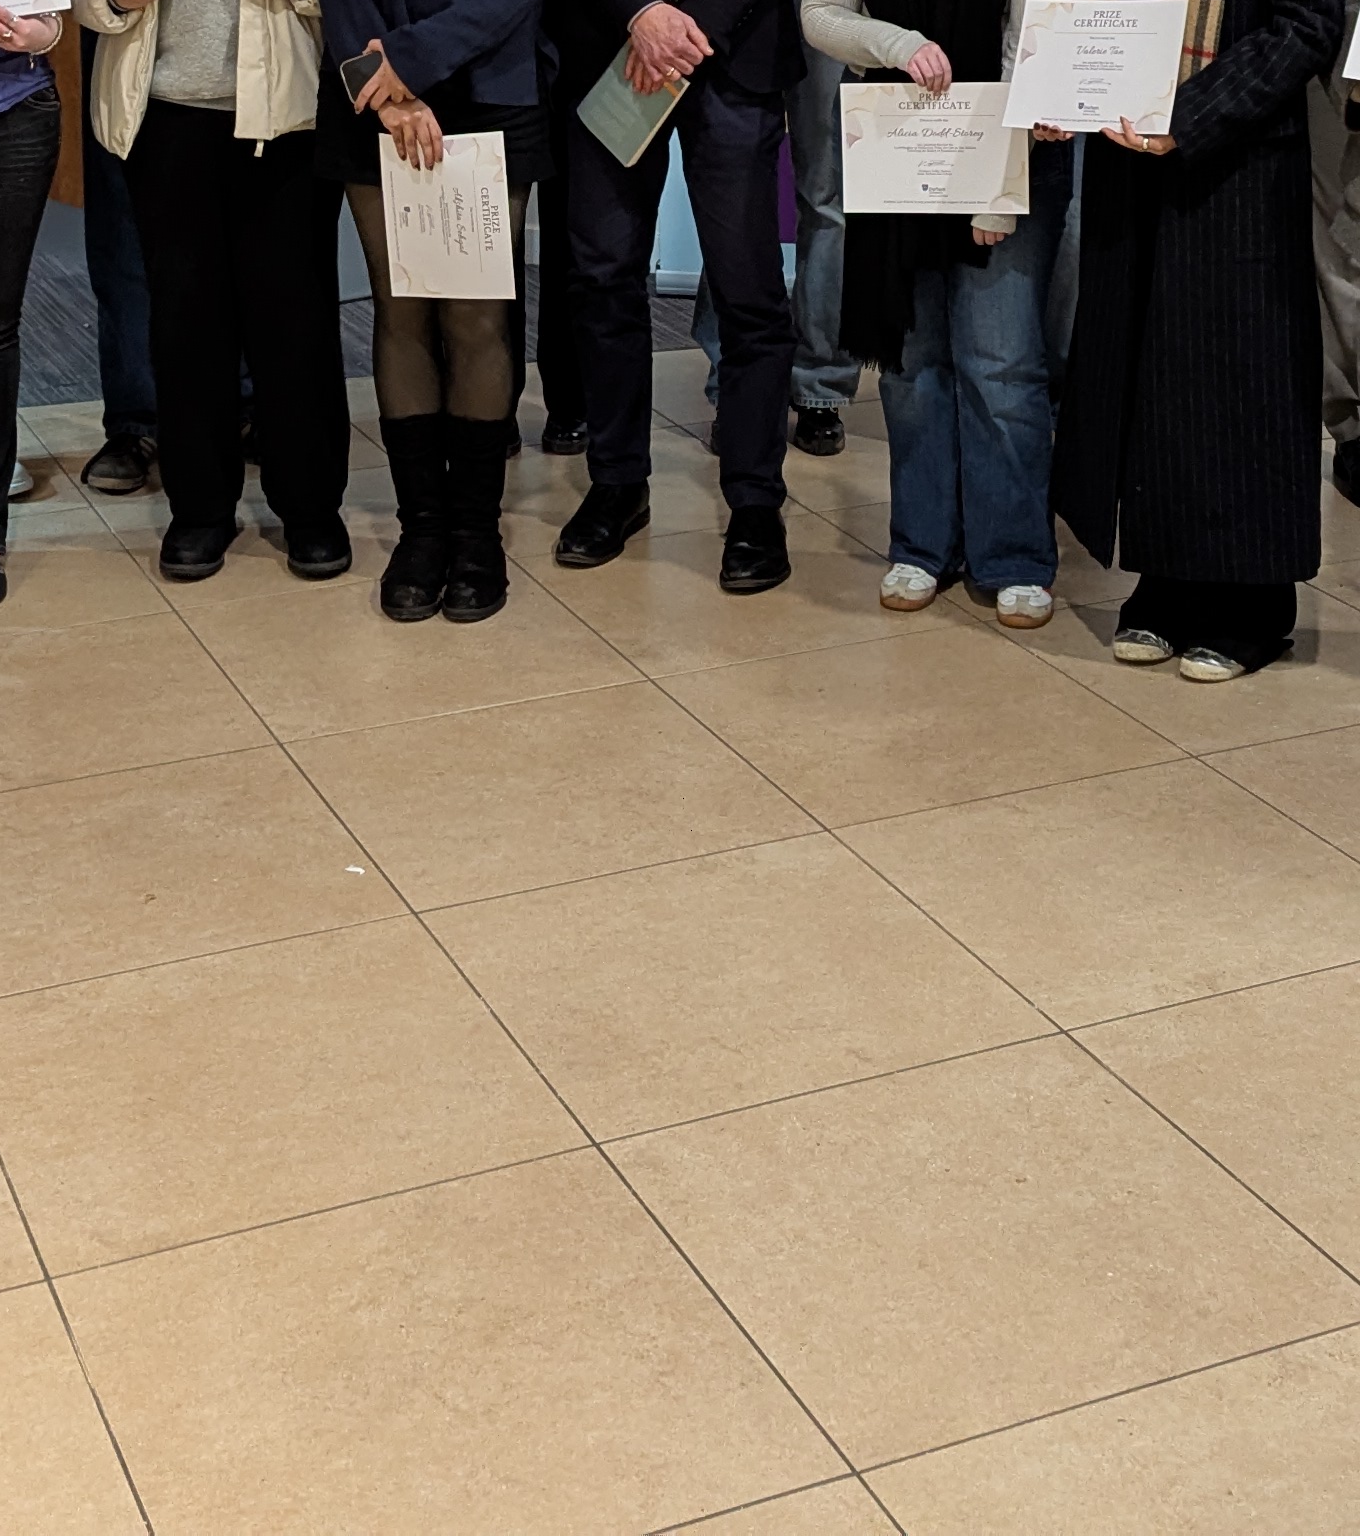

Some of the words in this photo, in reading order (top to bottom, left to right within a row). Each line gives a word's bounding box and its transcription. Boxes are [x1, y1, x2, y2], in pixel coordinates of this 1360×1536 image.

[1093, 10, 1122, 19] PRIZE
[1073, 19, 1138, 28] CERTIFICATE
[1076, 45, 1107, 55] Valerie
[919, 93, 950, 101] PRIZE
[898, 101, 971, 110] CERTIFICATE
[887, 128, 918, 138] Alicia
[480, 187, 494, 252] CERTIFICATE
[490, 205, 501, 234] PRIZE
